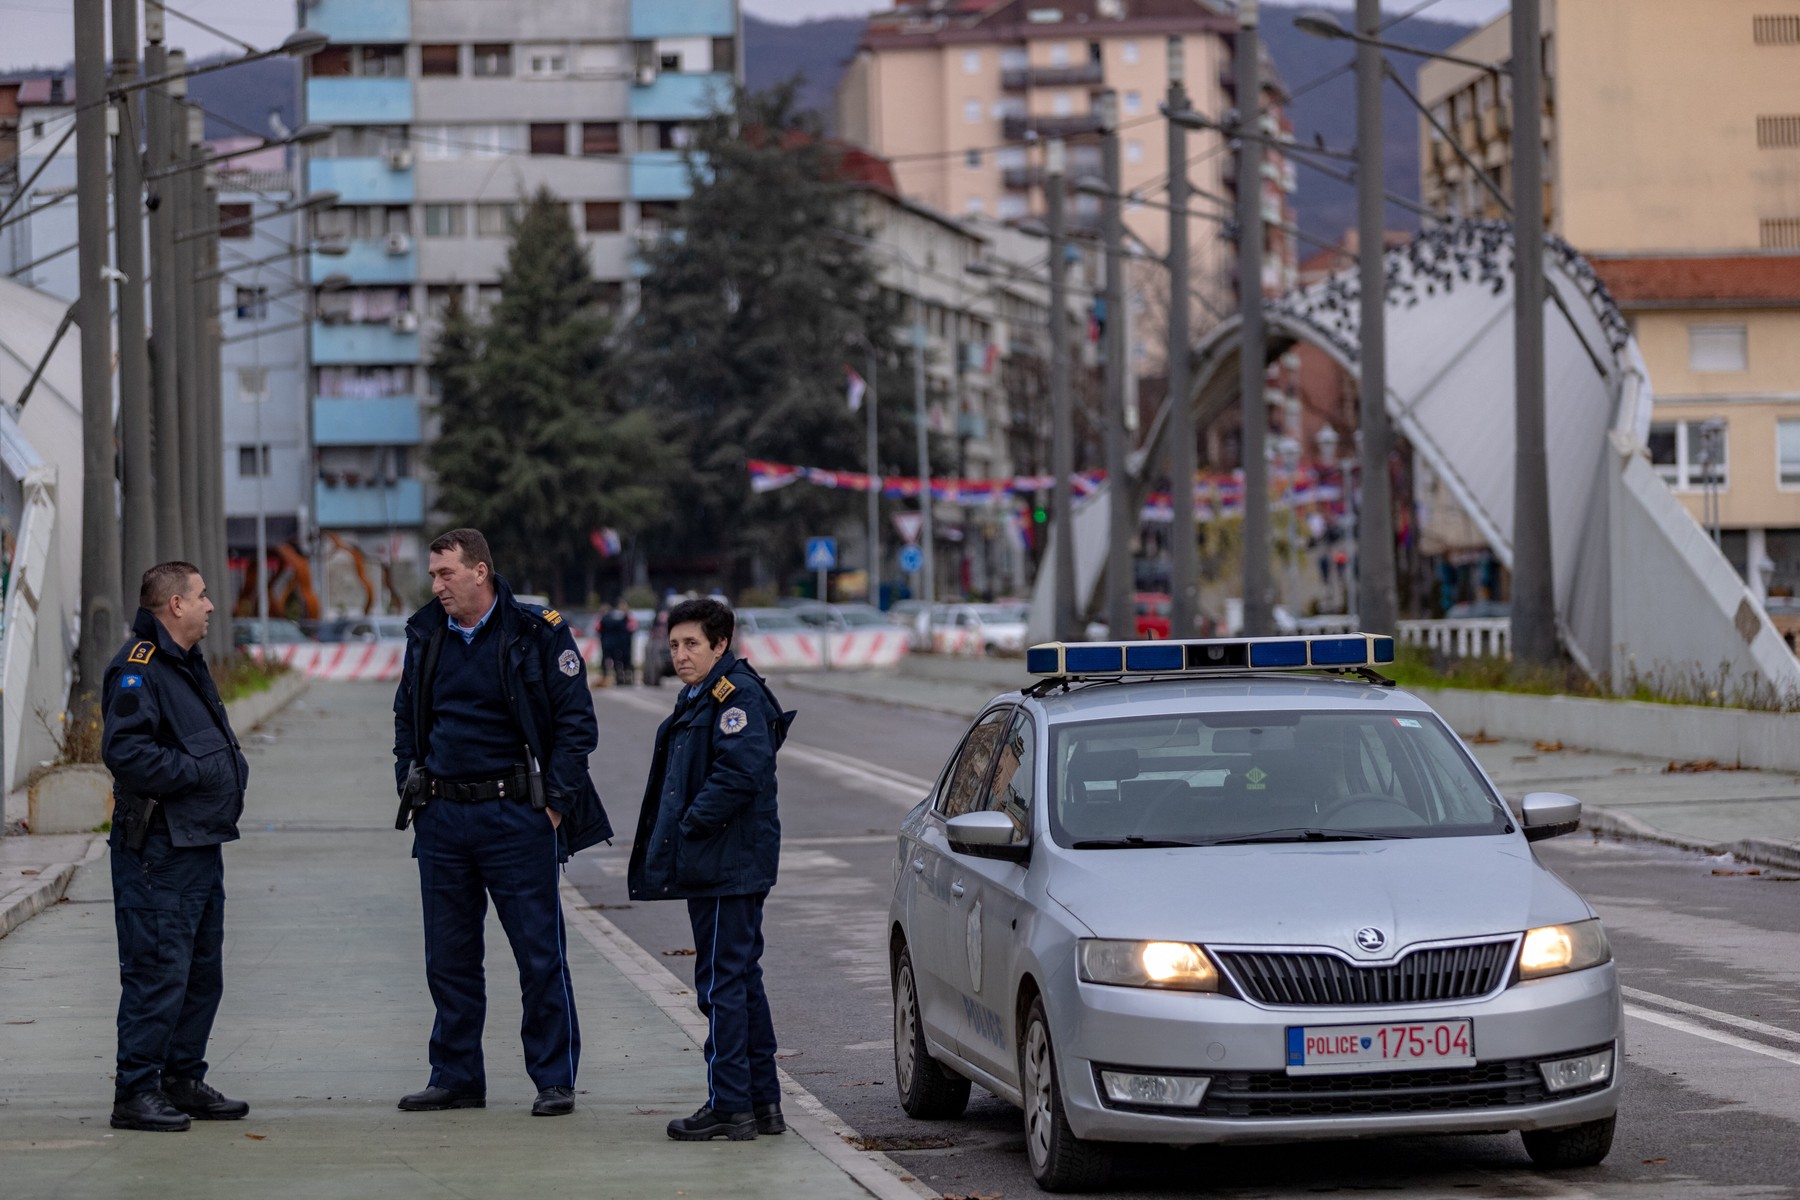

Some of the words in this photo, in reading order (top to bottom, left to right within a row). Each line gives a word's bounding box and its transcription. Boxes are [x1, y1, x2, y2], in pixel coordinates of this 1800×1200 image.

[963, 994, 1006, 1050] POLICE
[1306, 1035, 1359, 1055] POLICE
[1377, 1024, 1468, 1058] 175-04
